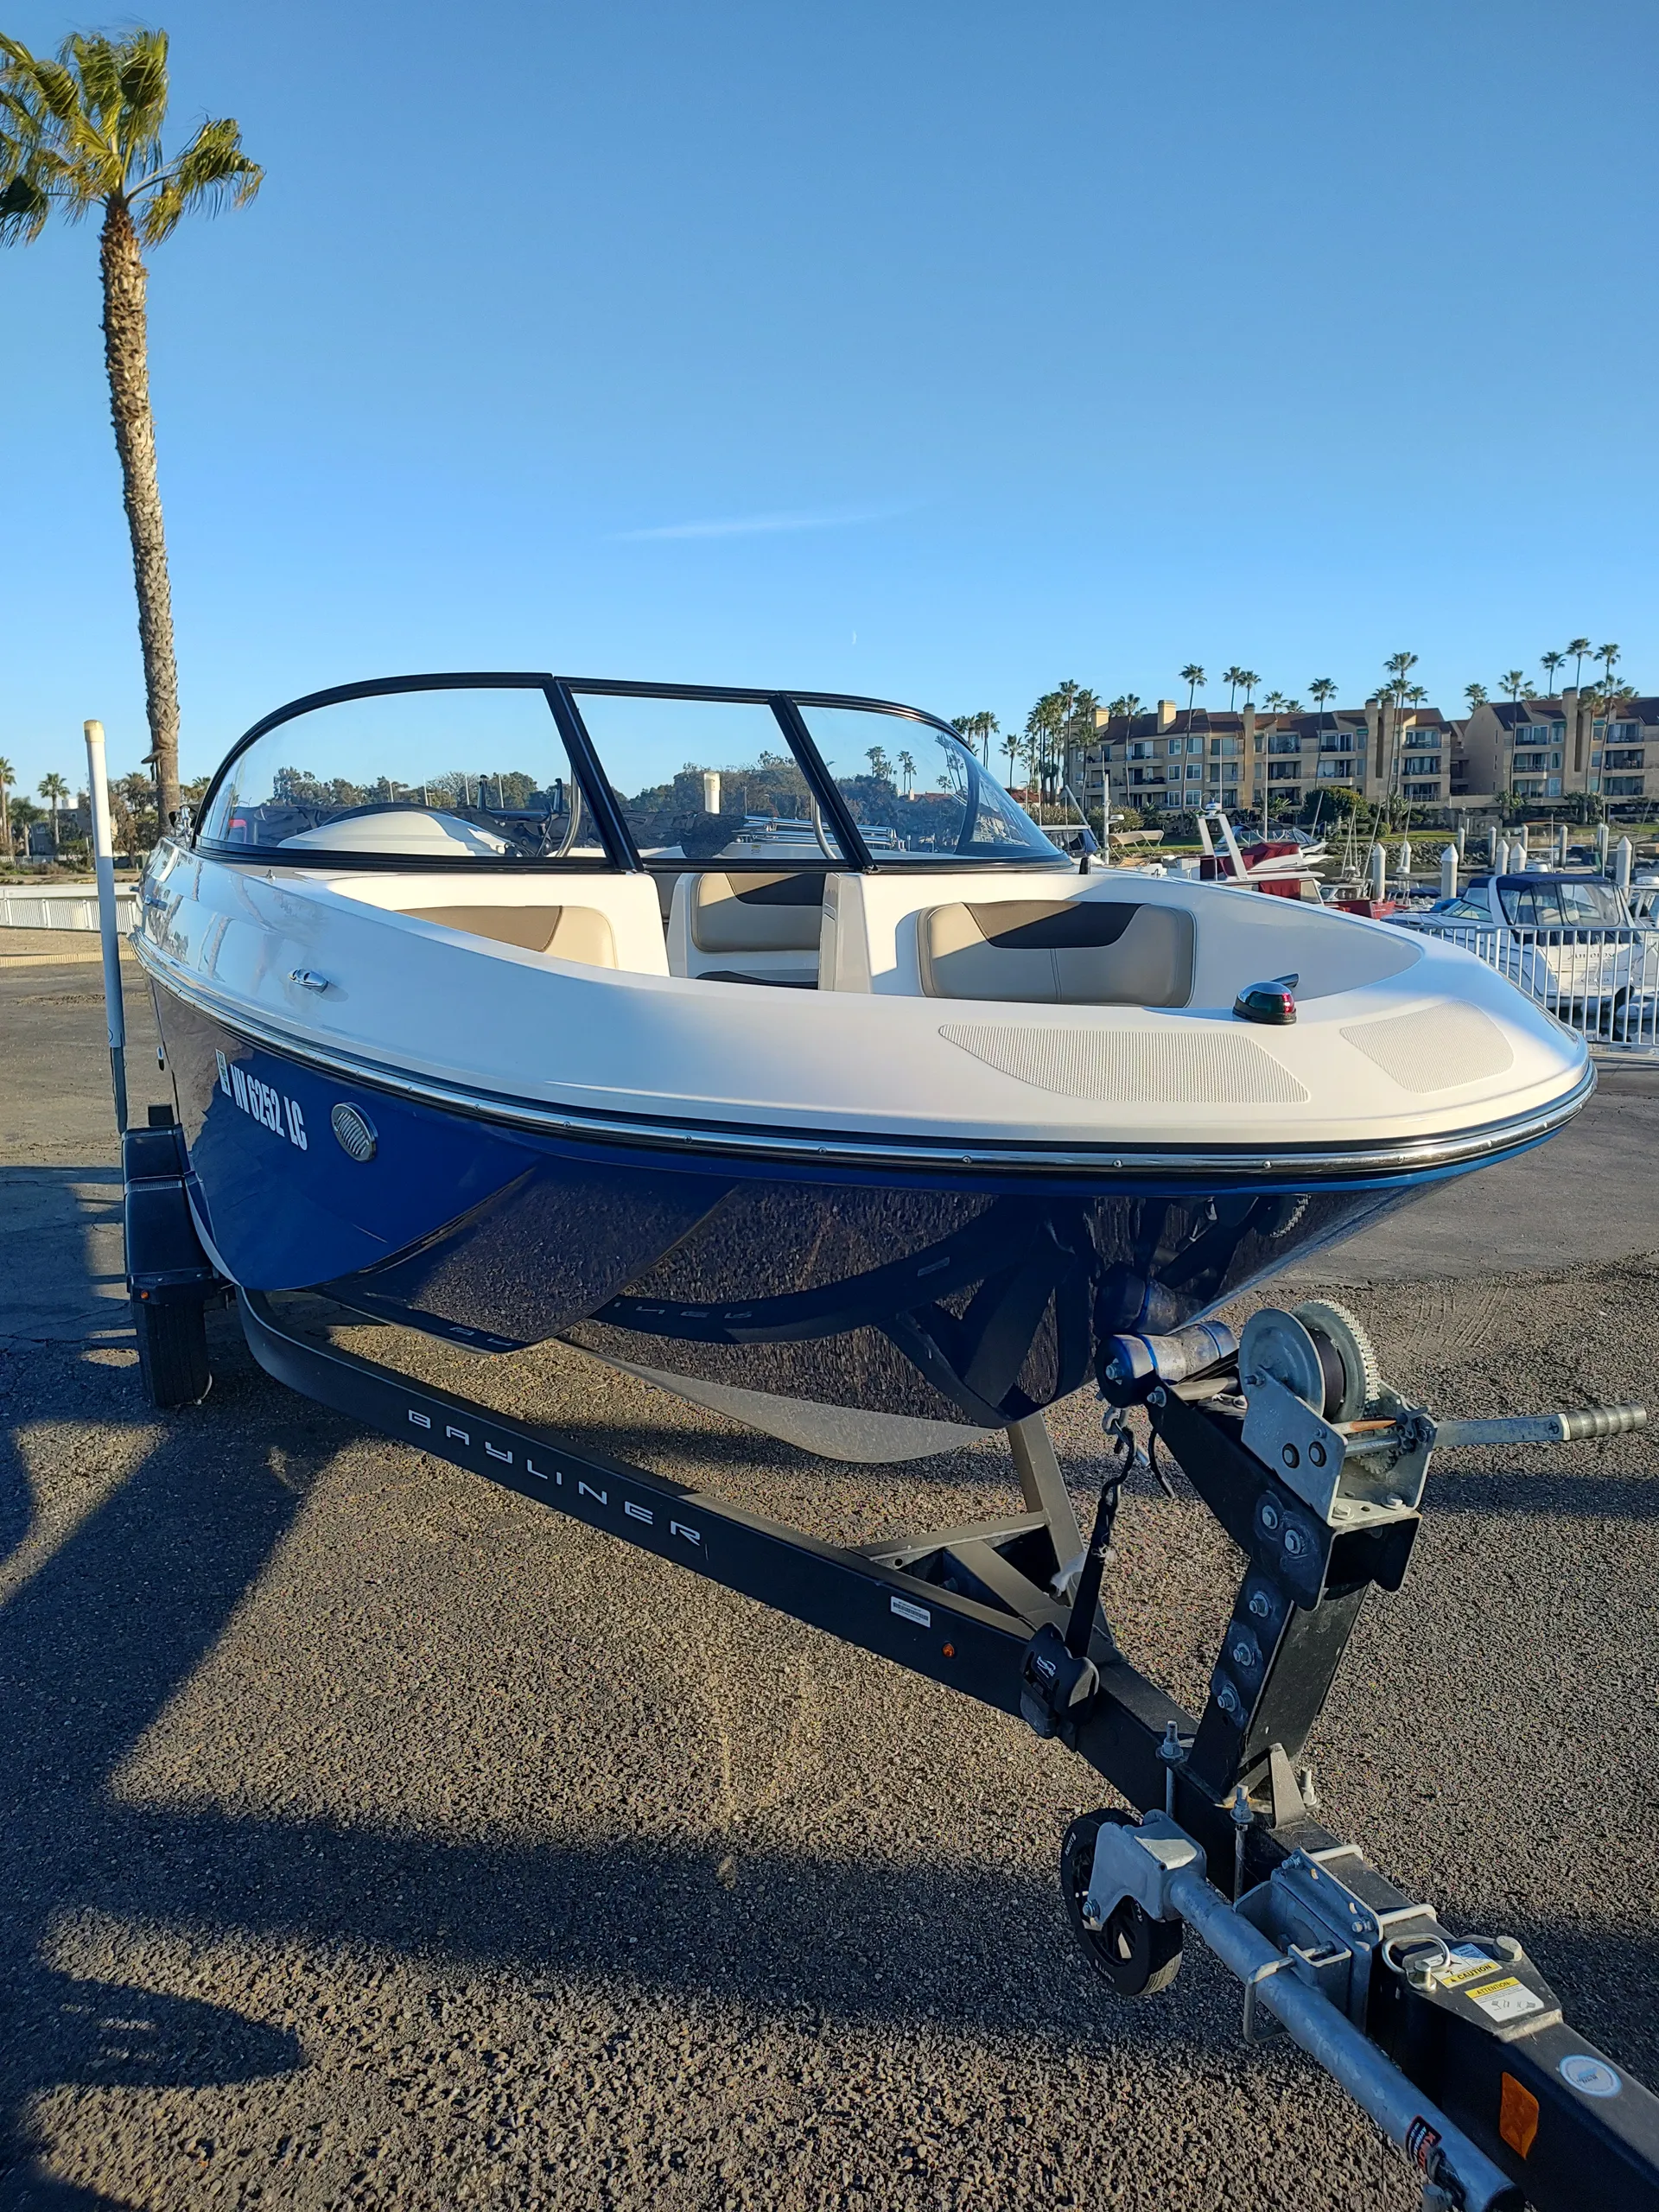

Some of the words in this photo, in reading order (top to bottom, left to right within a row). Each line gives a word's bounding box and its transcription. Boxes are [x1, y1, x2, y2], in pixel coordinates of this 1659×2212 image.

[246, 1074, 285, 1137] 6252
[283, 1096, 308, 1151] LC
[408, 1409, 701, 1546] BAYLINER
[1457, 1964, 1492, 1980] CAUTION
